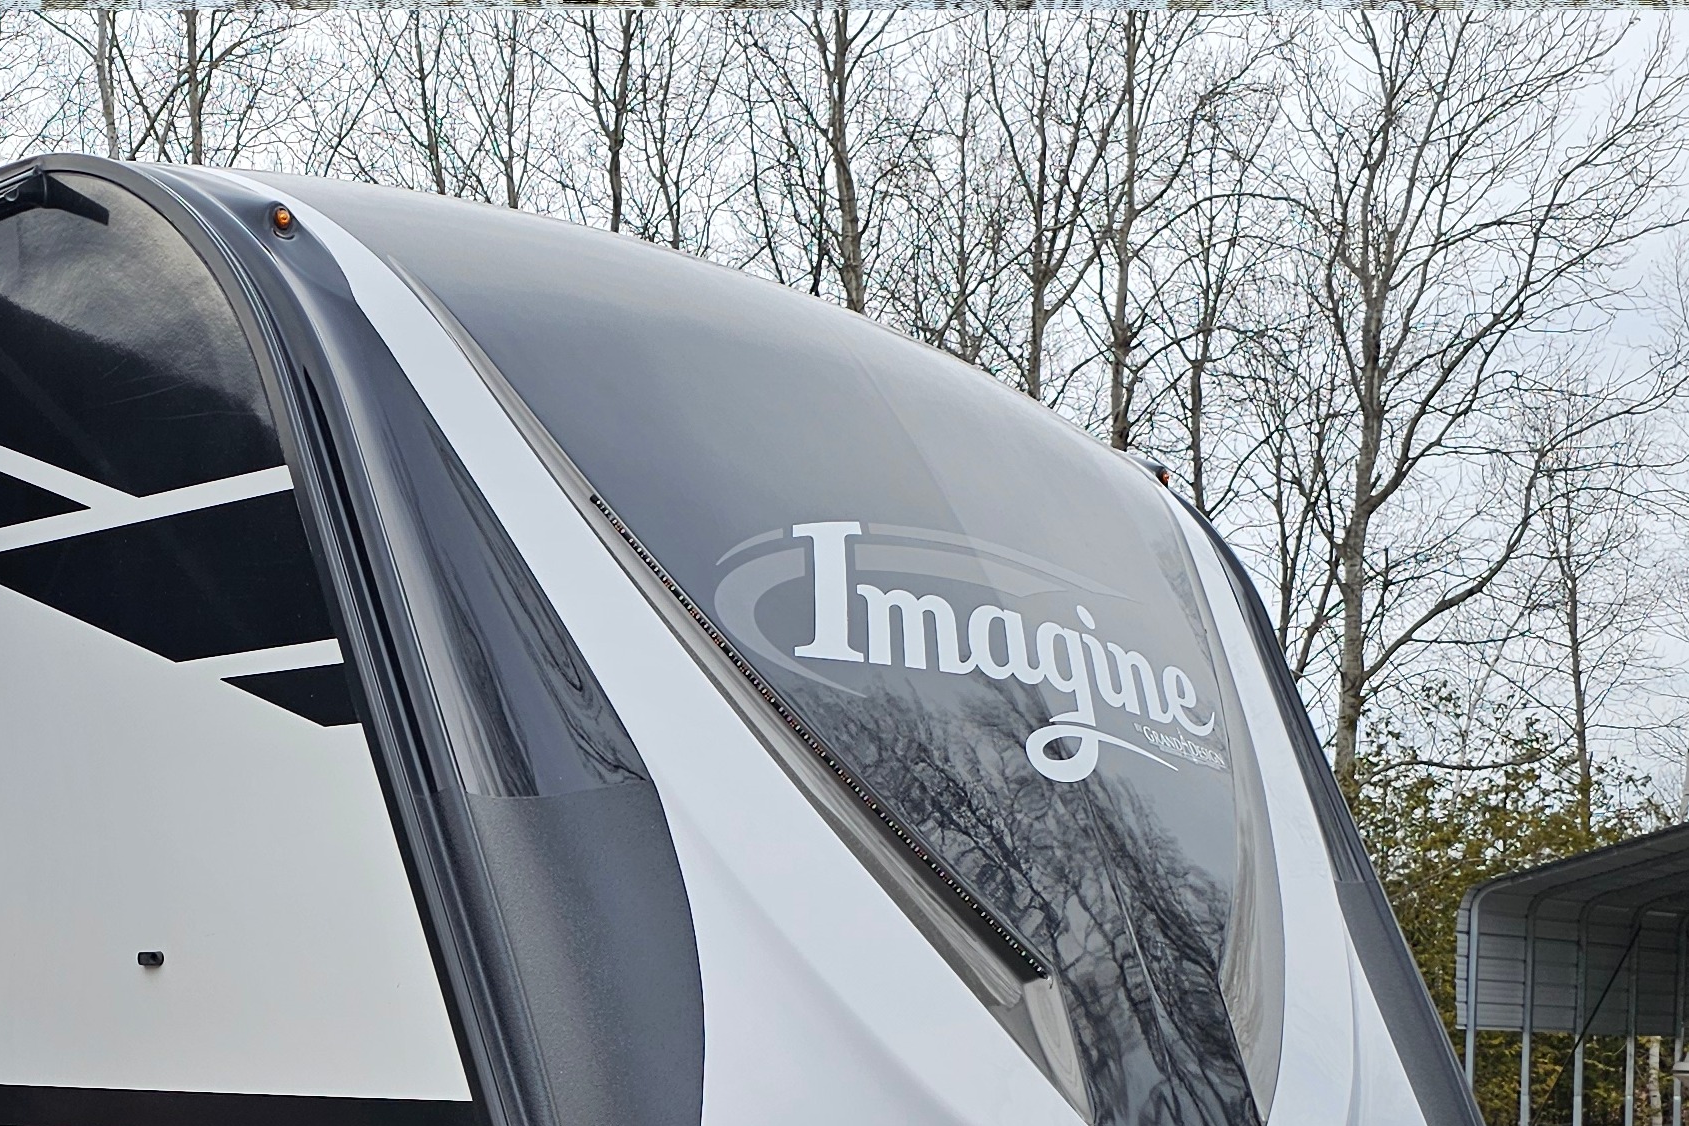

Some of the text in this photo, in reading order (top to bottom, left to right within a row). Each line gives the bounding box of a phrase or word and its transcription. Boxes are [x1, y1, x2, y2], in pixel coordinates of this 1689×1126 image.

[792, 521, 1215, 783] Imagine
[1142, 725, 1183, 752] GRAND
[1186, 740, 1226, 766] DESIGN
